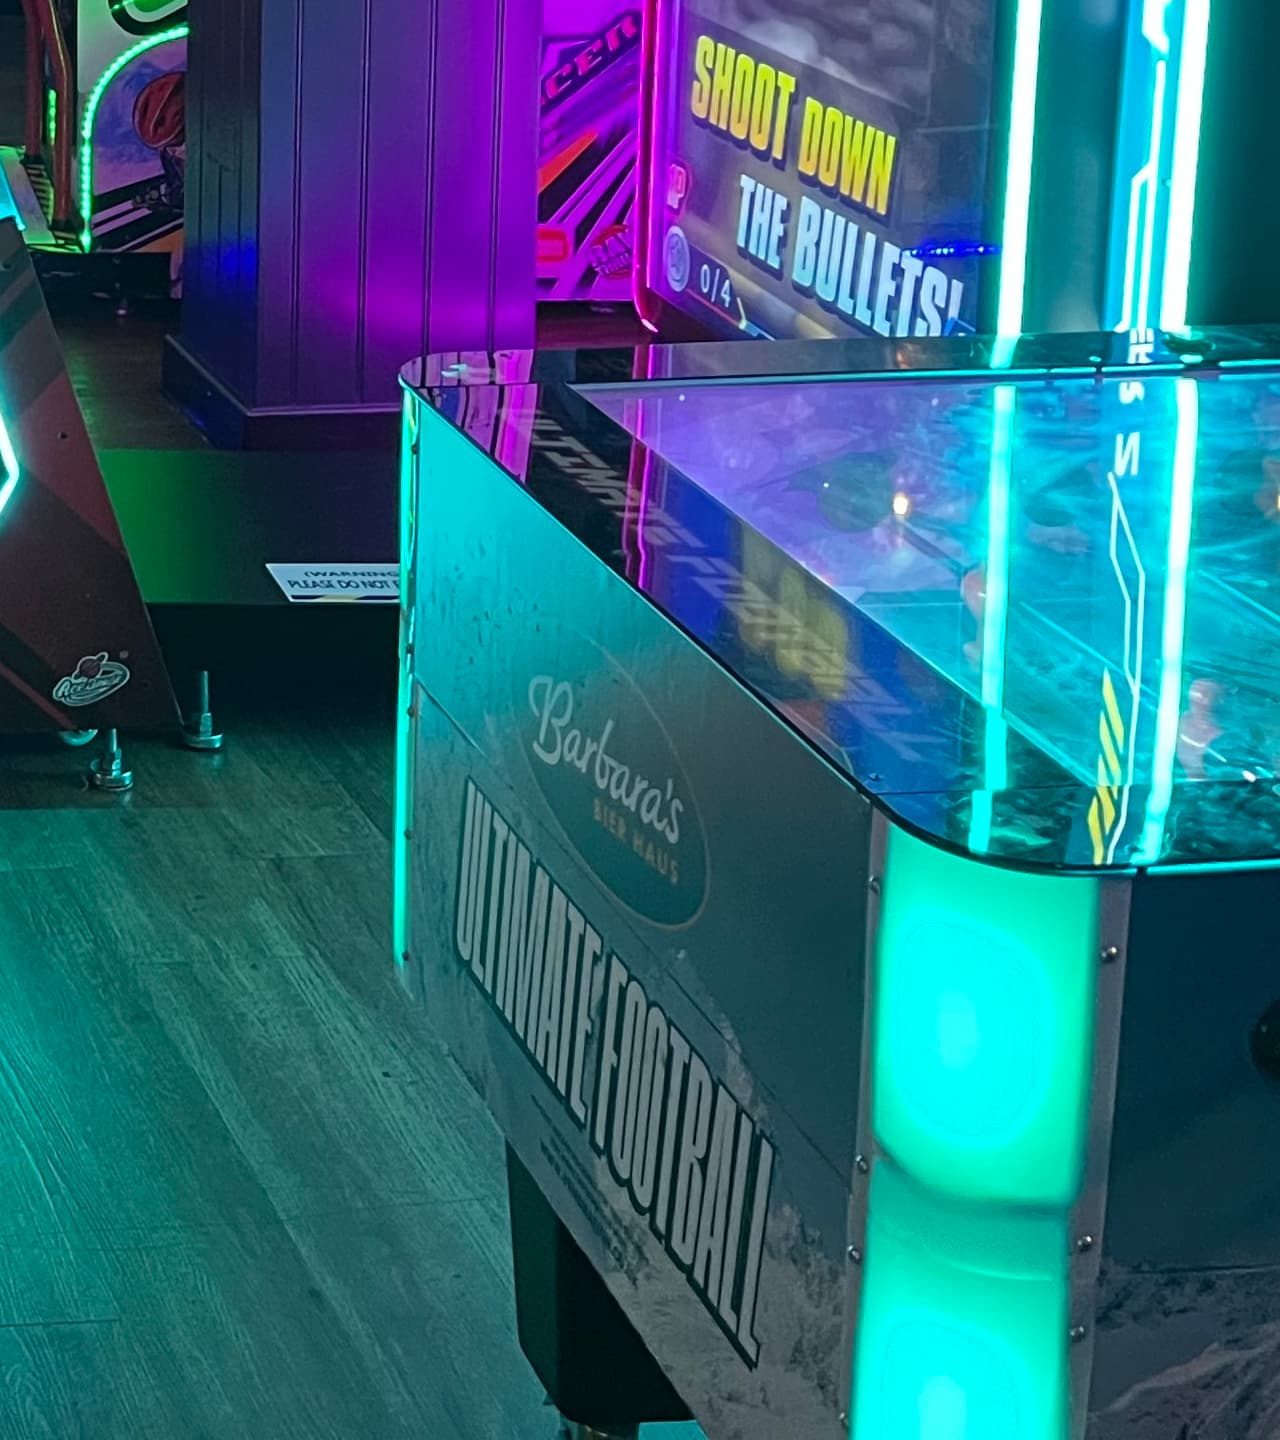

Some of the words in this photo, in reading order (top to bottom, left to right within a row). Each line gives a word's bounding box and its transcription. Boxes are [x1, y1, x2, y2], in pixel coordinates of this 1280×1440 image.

[691, 35, 796, 160] SHOOT
[798, 96, 898, 216] DOWN
[699, 269, 732, 309] 0/4
[736, 174, 789, 271] THE
[792, 195, 964, 337] BULLETS!
[288, 580, 335, 589] PLEASE
[337, 580, 361, 589] DO
[364, 580, 390, 589] NOT
[528, 674, 684, 845] Barbara's
[593, 799, 628, 843] BIER
[632, 832, 680, 886] HAUS
[455, 776, 604, 1130] ULTIMATE
[593, 951, 776, 1368] FOOTBALL
